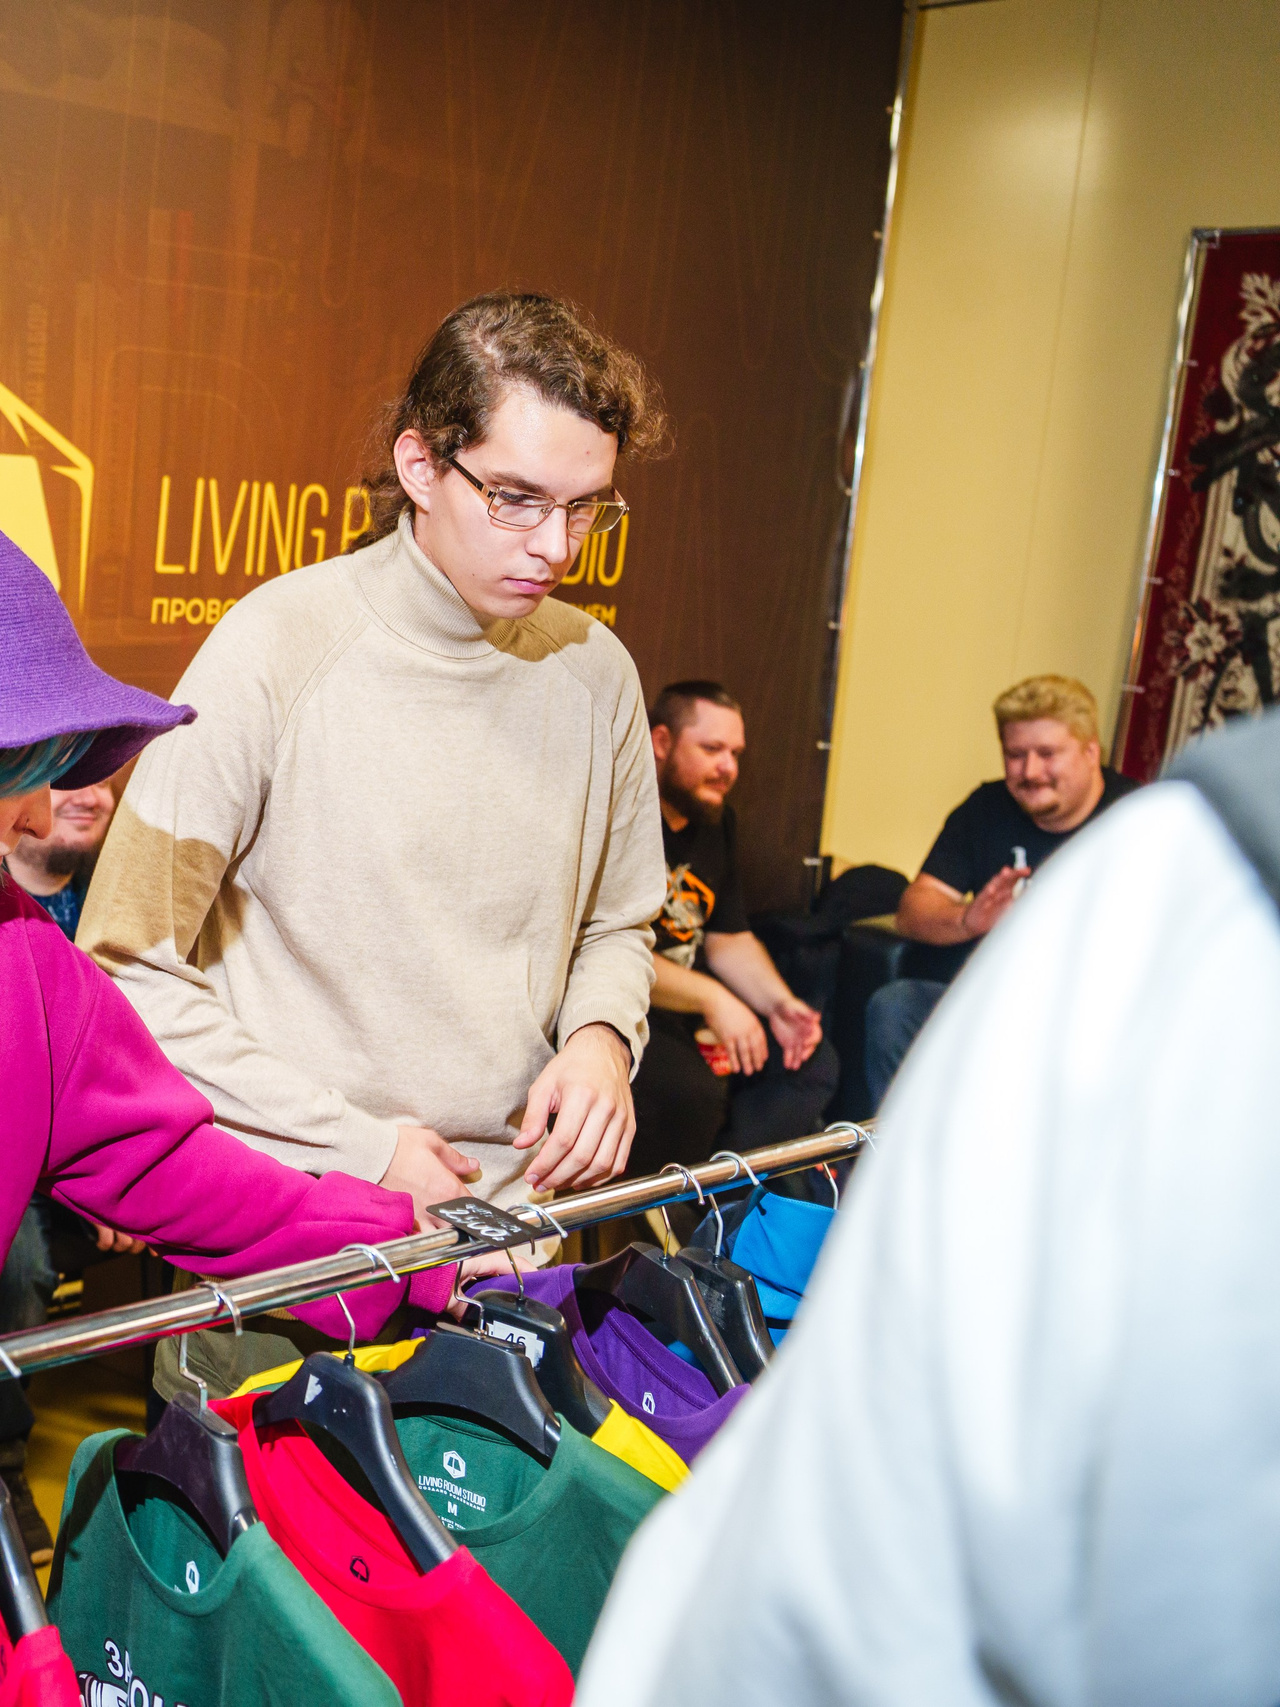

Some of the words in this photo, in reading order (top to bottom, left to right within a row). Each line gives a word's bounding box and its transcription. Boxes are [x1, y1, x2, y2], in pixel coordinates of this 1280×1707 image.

[155, 475, 330, 577] LIVING
[418, 1475, 443, 1489] LIVING
[443, 1479, 462, 1497] ROOM
[462, 1488, 486, 1507] STUDIO
[447, 1500, 458, 1516] M
